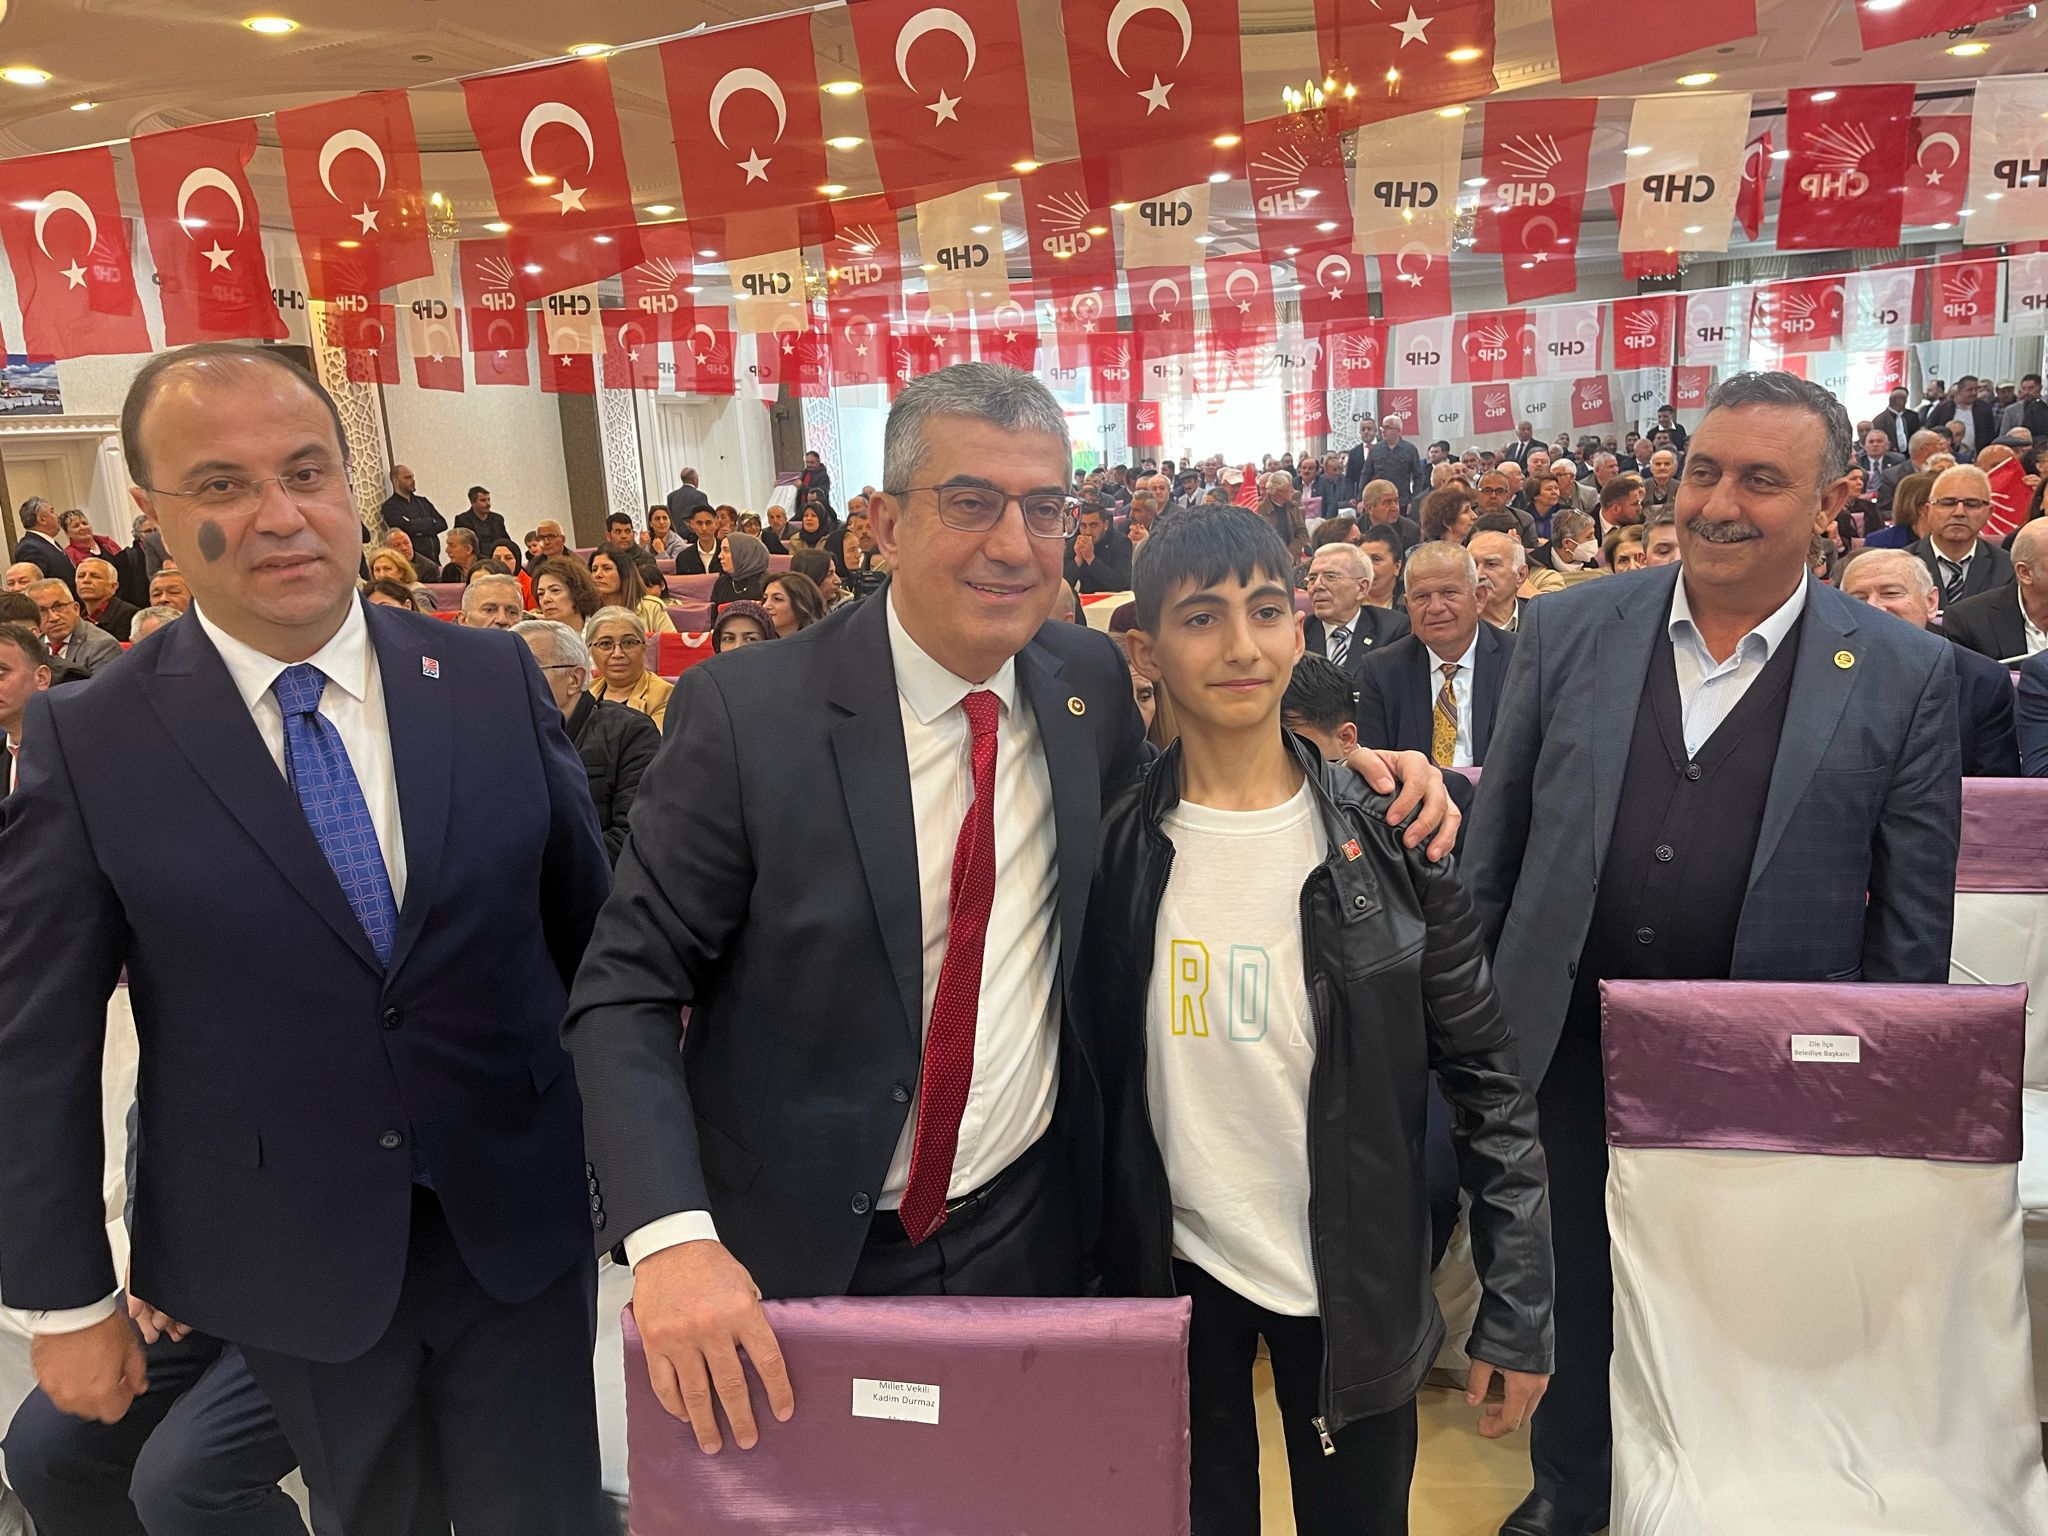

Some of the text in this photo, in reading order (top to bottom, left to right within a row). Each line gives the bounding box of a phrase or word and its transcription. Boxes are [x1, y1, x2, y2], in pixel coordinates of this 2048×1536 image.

[1631, 391, 1654, 403] CHP
[1678, 390, 1699, 400] CHP
[1526, 402, 1547, 414] CHP
[1582, 399, 1604, 411] CHP
[1438, 413, 1459, 423] CHP
[1485, 407, 1506, 418] CHP
[1136, 422, 1155, 432] CHP
[1823, 1050, 1850, 1058] Başkanı
[879, 1382, 930, 1394] Millet Vekili
[873, 1393, 935, 1408] Kadim Durmaz
